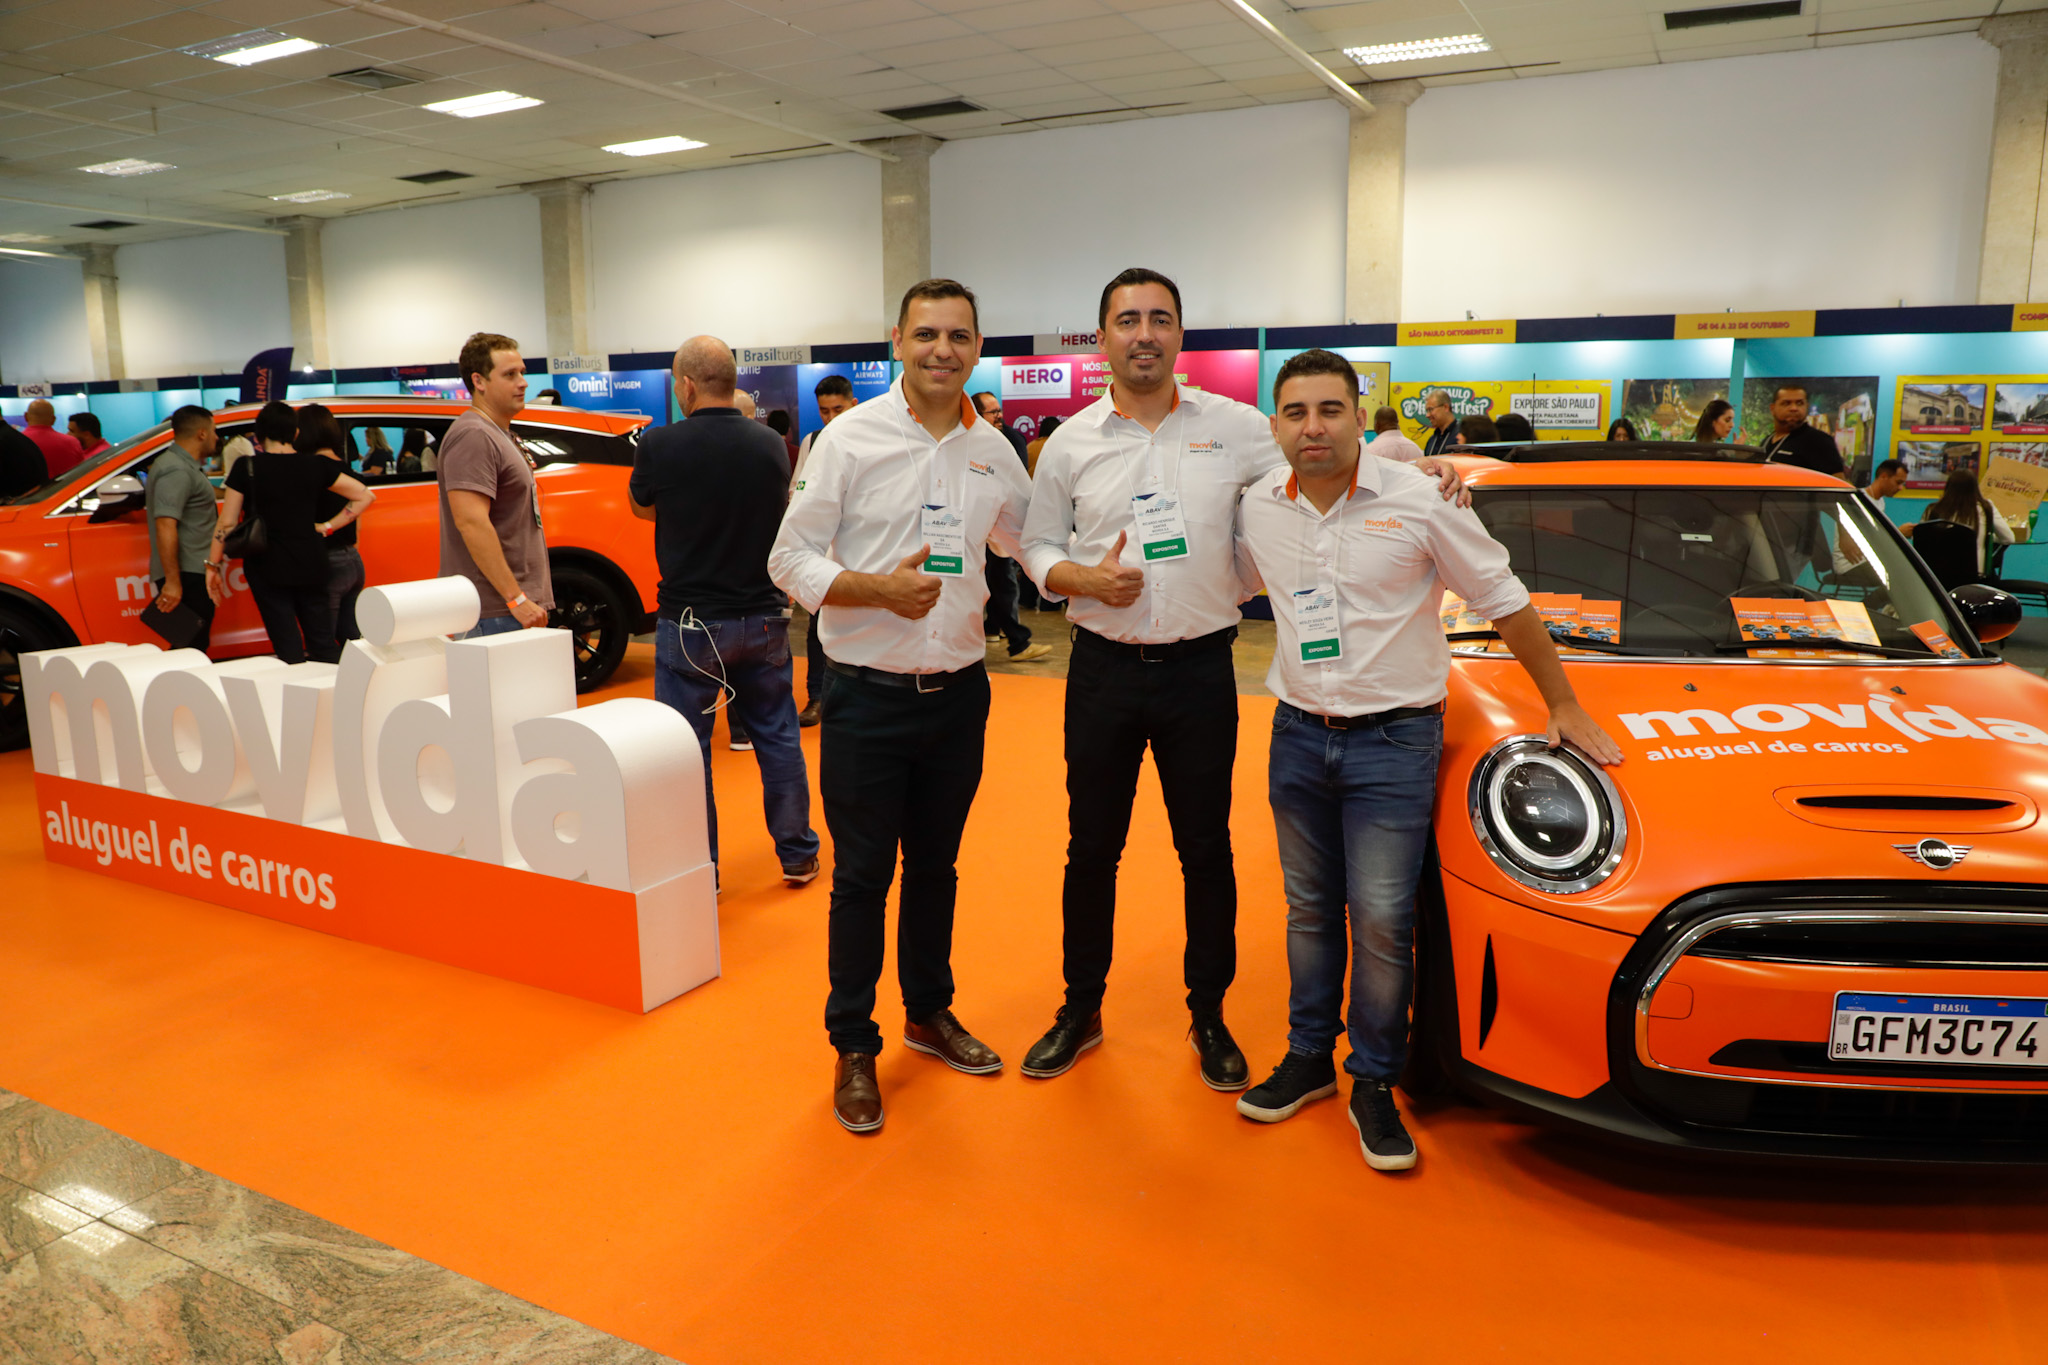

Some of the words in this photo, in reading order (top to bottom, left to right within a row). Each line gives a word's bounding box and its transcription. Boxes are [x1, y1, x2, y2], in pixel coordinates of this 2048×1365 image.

[1697, 322, 1708, 330] DE
[1720, 322, 1727, 330] A
[1739, 321, 1749, 329] DE
[1750, 320, 1791, 329] OUTUBRO
[1408, 328, 1422, 338] SÃO
[1423, 329, 1446, 338] PAULO
[1446, 327, 1495, 337] OKTOBERFEST
[1061, 333, 1097, 346] HERO
[744, 348, 803, 362] Brasilturis
[553, 356, 602, 370] Brasilturis
[1082, 361, 1101, 372] NÓS
[855, 371, 883, 379] AIRWAYS
[1013, 368, 1063, 384] HERO
[1082, 376, 1088, 384] A
[1088, 376, 1104, 384] SUA
[613, 381, 641, 390] VIAGEM
[1514, 398, 1549, 409] EXPLORE
[1551, 396, 1567, 409] SÃO
[1569, 398, 1595, 409] PAULO
[1152, 544, 1178, 553] EXPOSITOR
[1617, 693, 2048, 746] movida
[19, 577, 640, 893] movida
[1646, 741, 1762, 761] aluguel
[1767, 740, 1808, 754] de
[1813, 739, 1909, 754] carros
[46, 800, 162, 866] aluguel
[169, 826, 212, 879] de
[220, 850, 337, 910] carros
[1933, 1003, 1971, 1013] BRASIL
[1852, 1016, 2038, 1059] GFM3C74
[1835, 1043, 1848, 1055] BR
